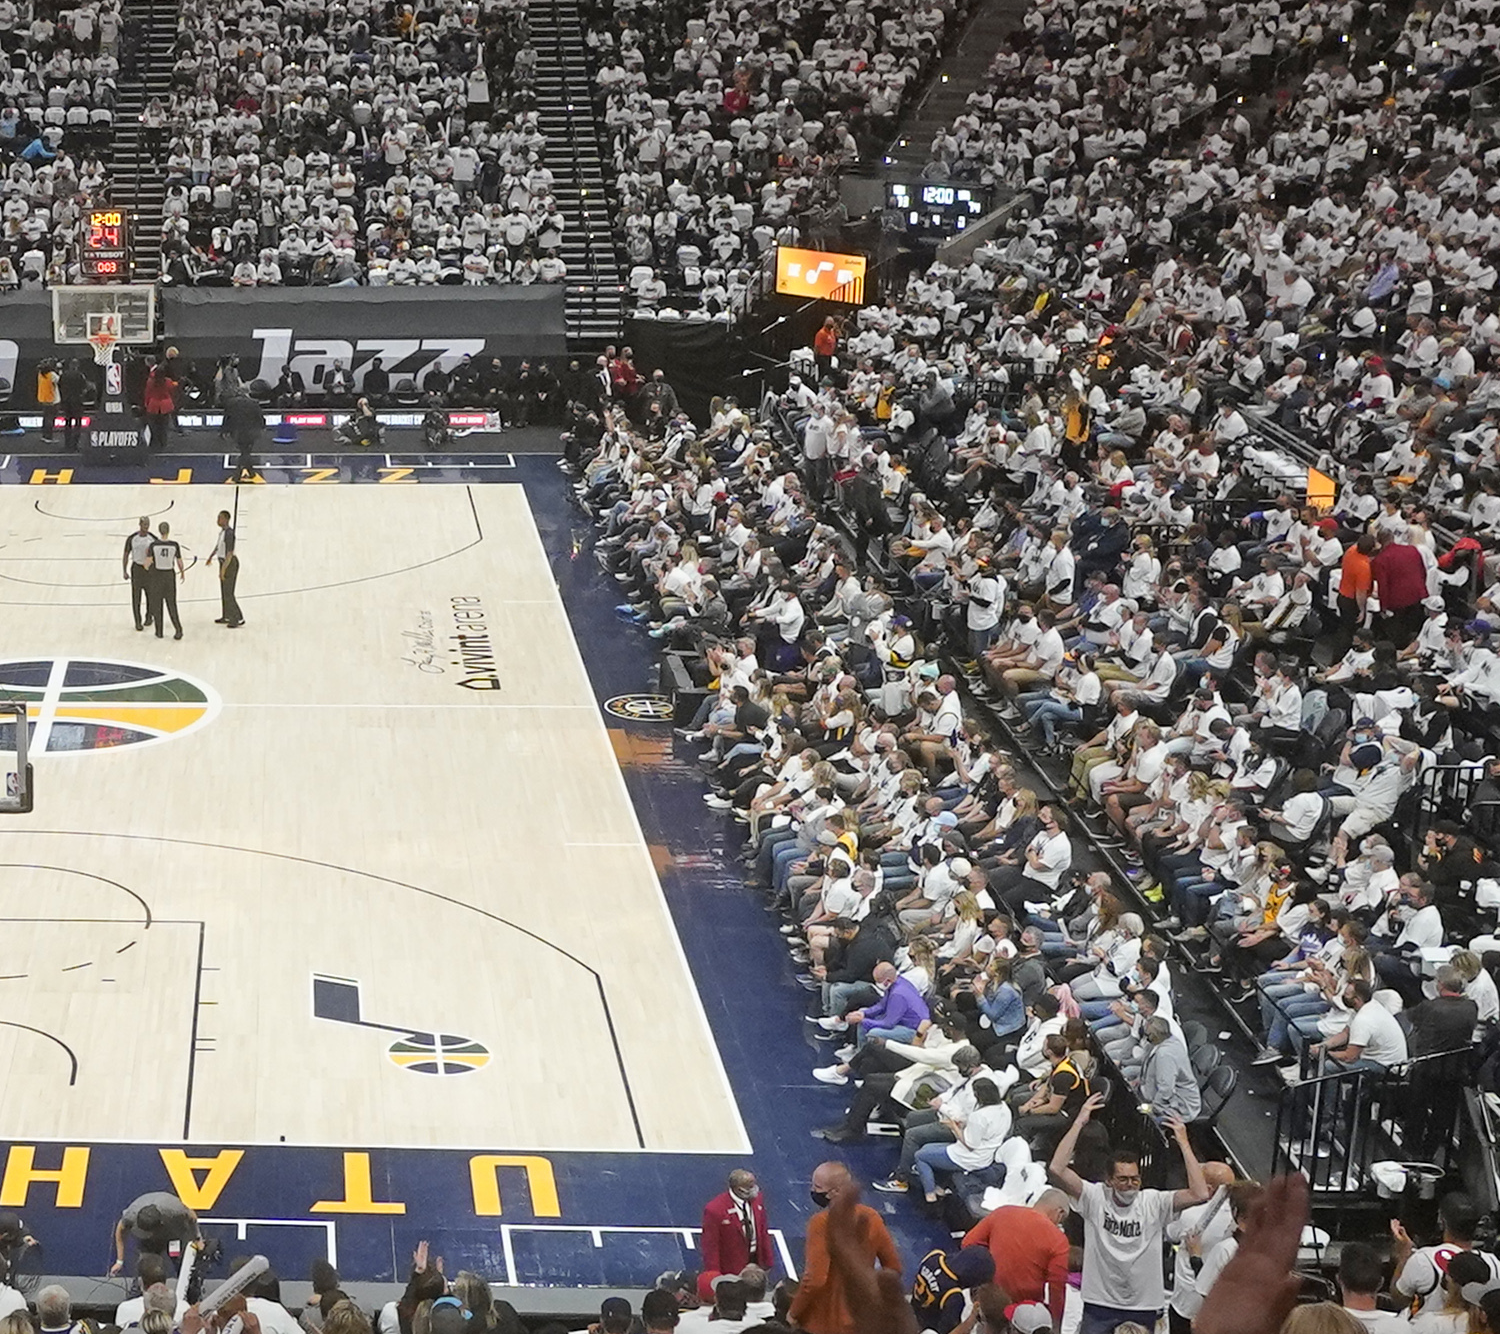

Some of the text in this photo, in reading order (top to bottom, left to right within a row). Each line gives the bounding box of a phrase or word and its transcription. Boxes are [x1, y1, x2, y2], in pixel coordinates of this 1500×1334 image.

[923, 186, 955, 205] 12:00
[91, 213, 121, 228] 12:00
[252, 328, 485, 394] Jazz
[100, 430, 139, 447] PLAYOFFS
